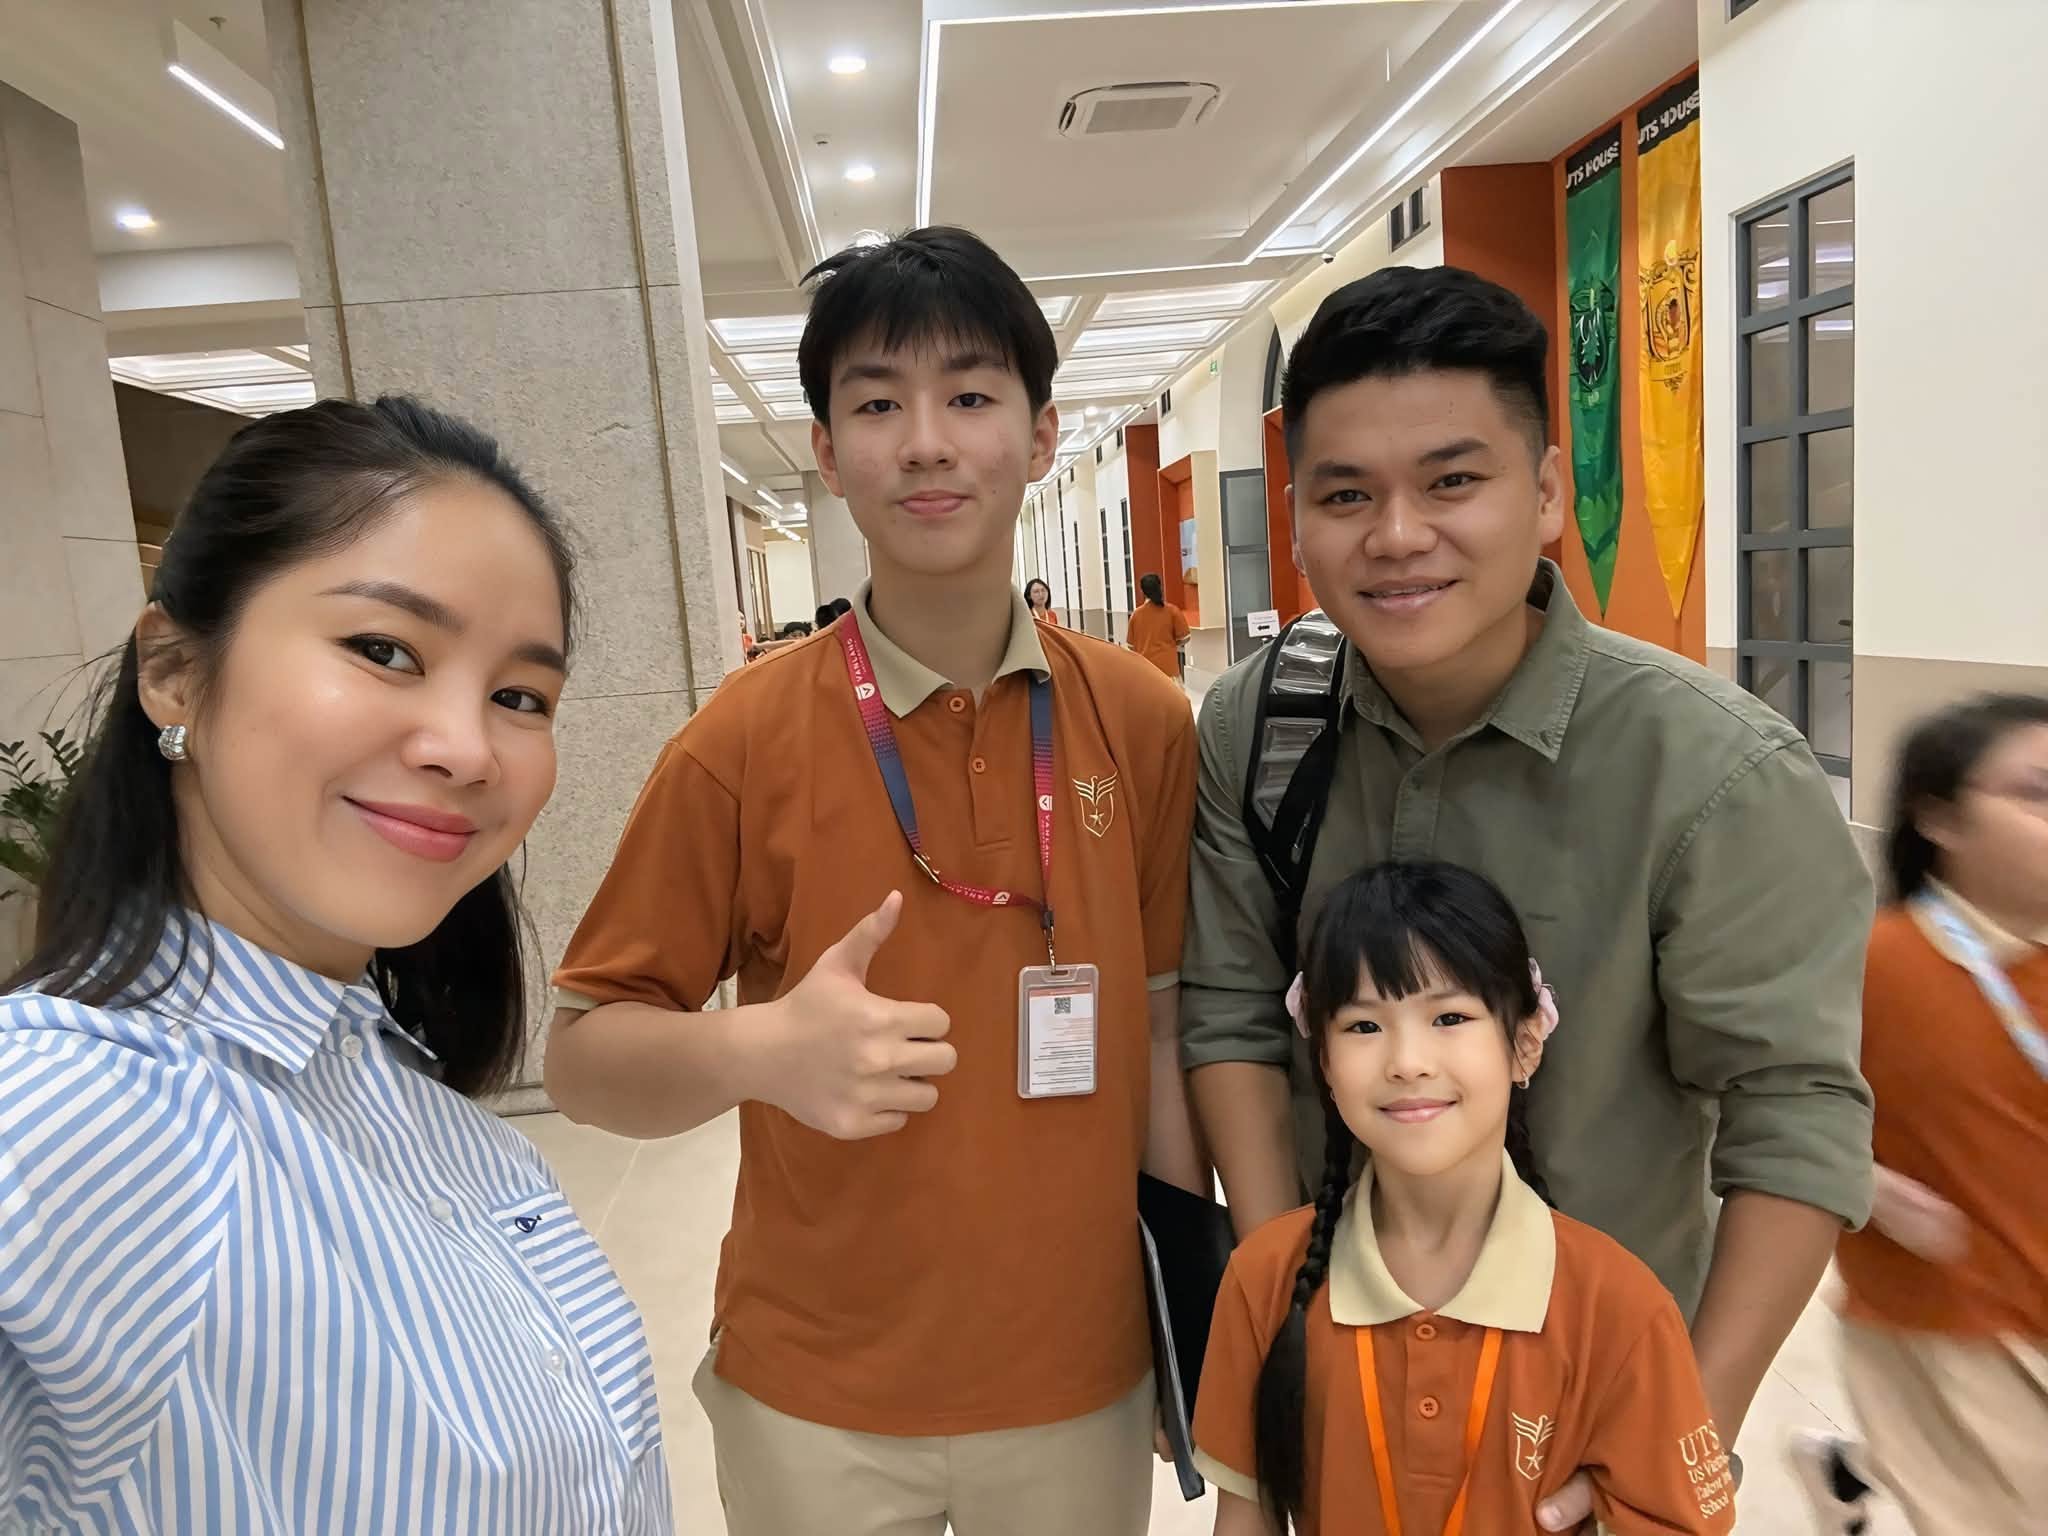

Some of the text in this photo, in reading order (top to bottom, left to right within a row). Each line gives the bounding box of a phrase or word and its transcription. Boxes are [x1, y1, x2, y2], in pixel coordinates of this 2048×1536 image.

[1660, 88, 1700, 128] HOUSE
[1585, 141, 1619, 177] HOUSE
[1678, 1418, 1720, 1466] UTS
[1687, 1465, 1705, 1484] US
[1699, 1491, 1730, 1519] School
